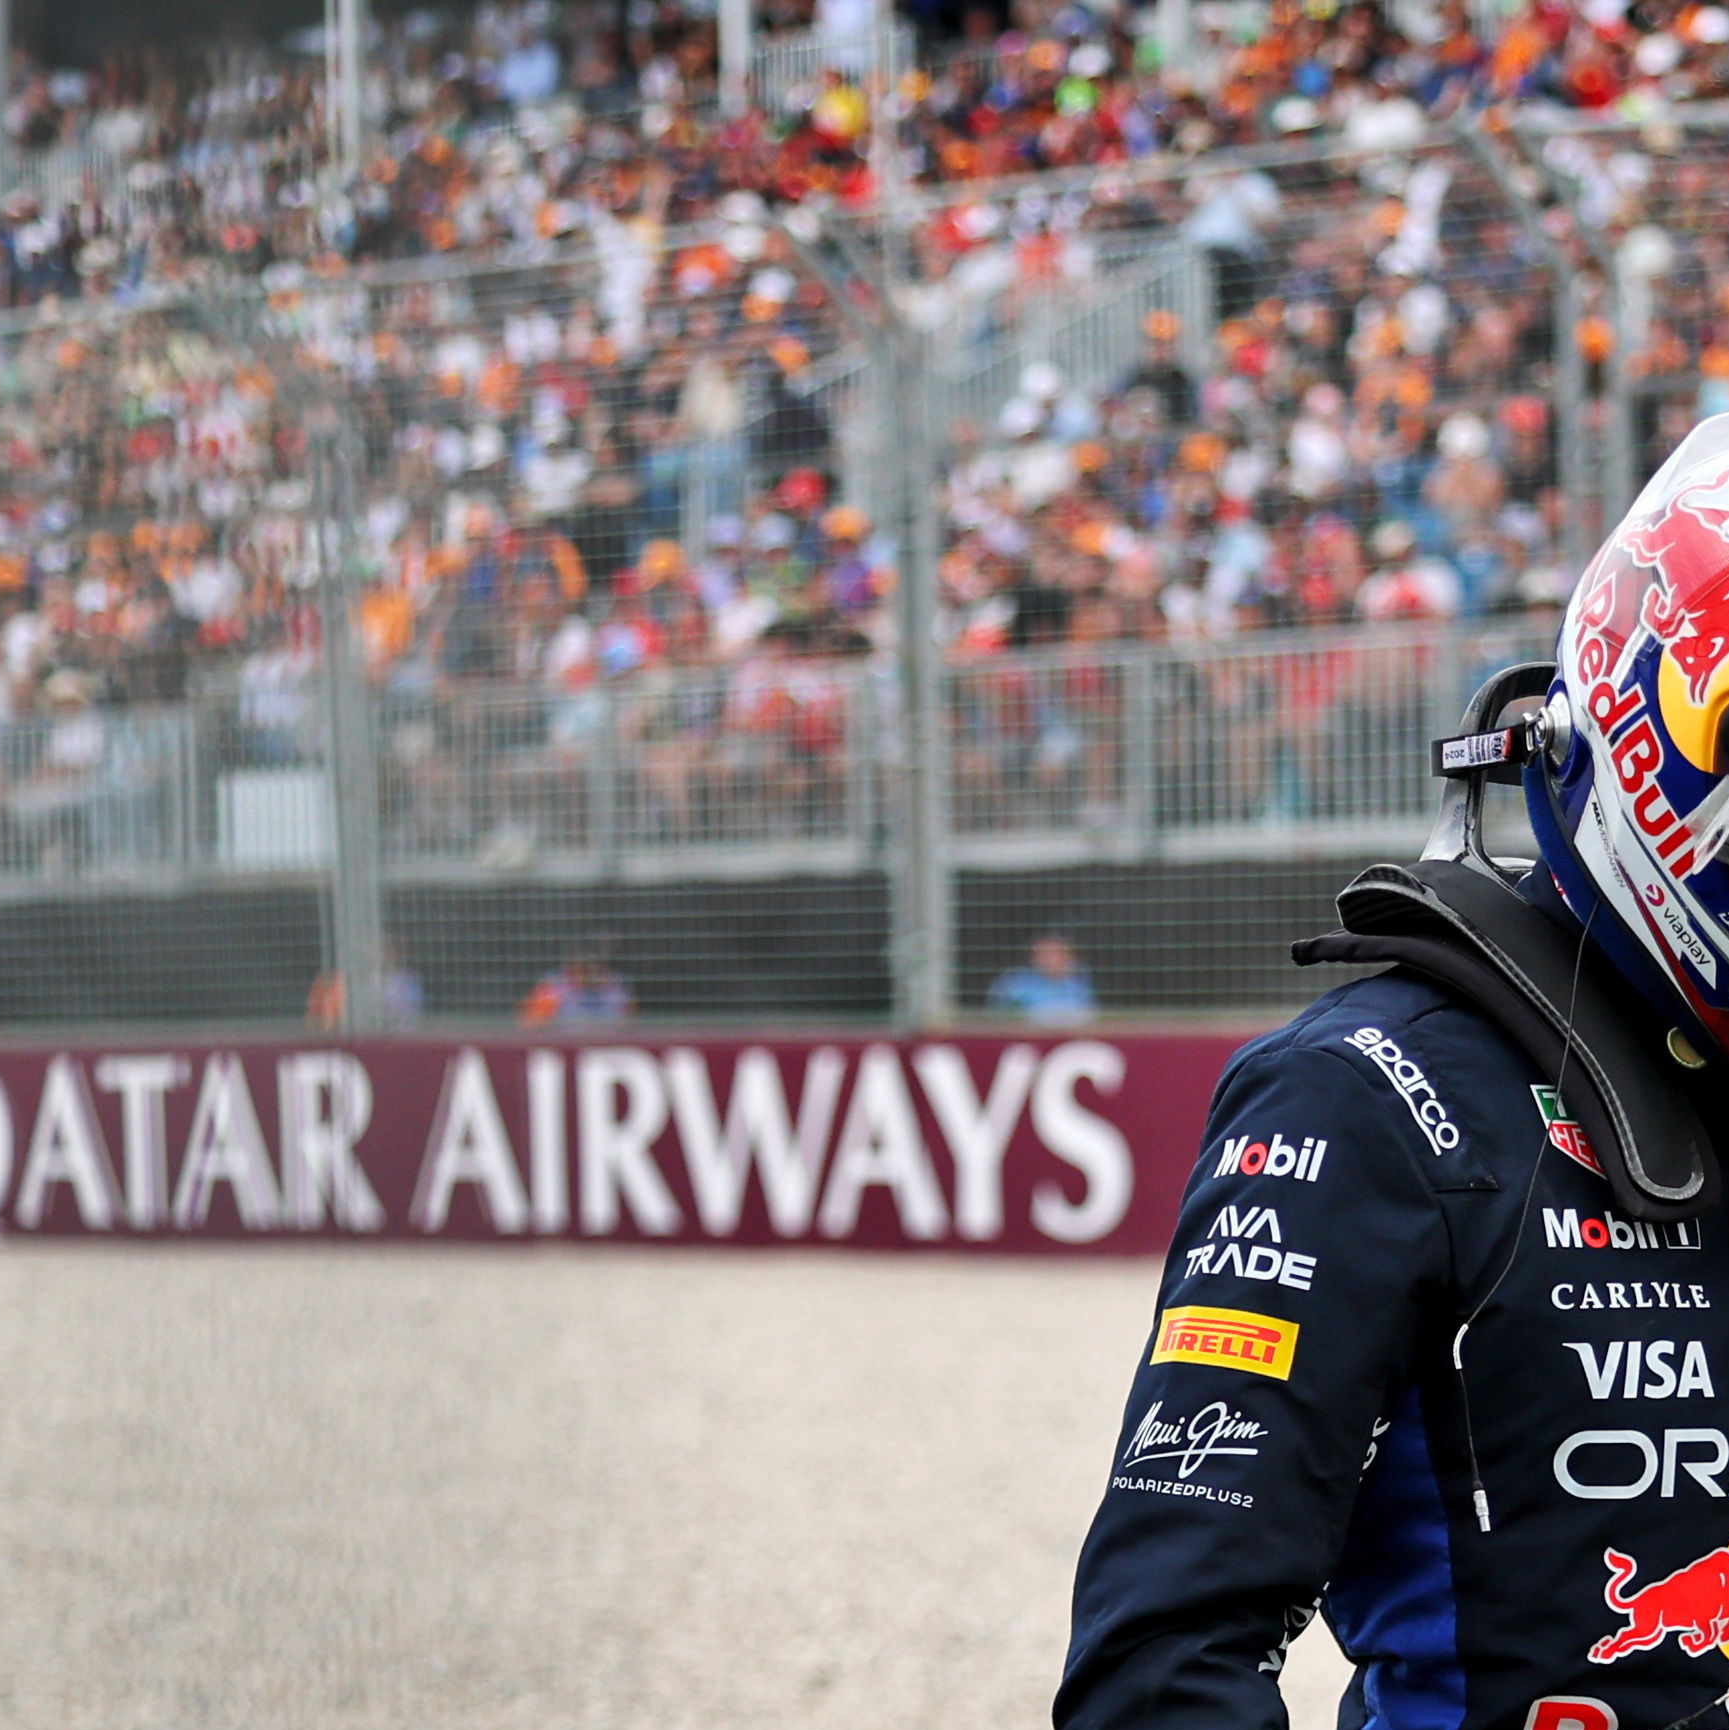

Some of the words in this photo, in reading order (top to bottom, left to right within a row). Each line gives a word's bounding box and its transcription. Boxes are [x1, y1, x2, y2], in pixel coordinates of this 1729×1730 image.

[1575, 572, 1646, 738] Red
[1611, 714, 1696, 880] Bull
[1664, 907, 1711, 966] viaplay
[1346, 1026, 1460, 1154] sparco
[408, 1040, 1135, 1244] AIRWAYS
[1212, 1133, 1328, 1183] Mobil
[1207, 1205, 1281, 1244] AVA
[1542, 1207, 1660, 1250] Mobil
[1185, 1243, 1317, 1291] TRADE
[1550, 1281, 1711, 1310] CARLYLE
[1160, 1317, 1281, 1364] PIRELLI
[1561, 1340, 1715, 1399] VISA
[1123, 1401, 1184, 1460] Maui
[1179, 1401, 1269, 1480] Jim
[1112, 1475, 1255, 1508] POLARIZEDPLUS2
